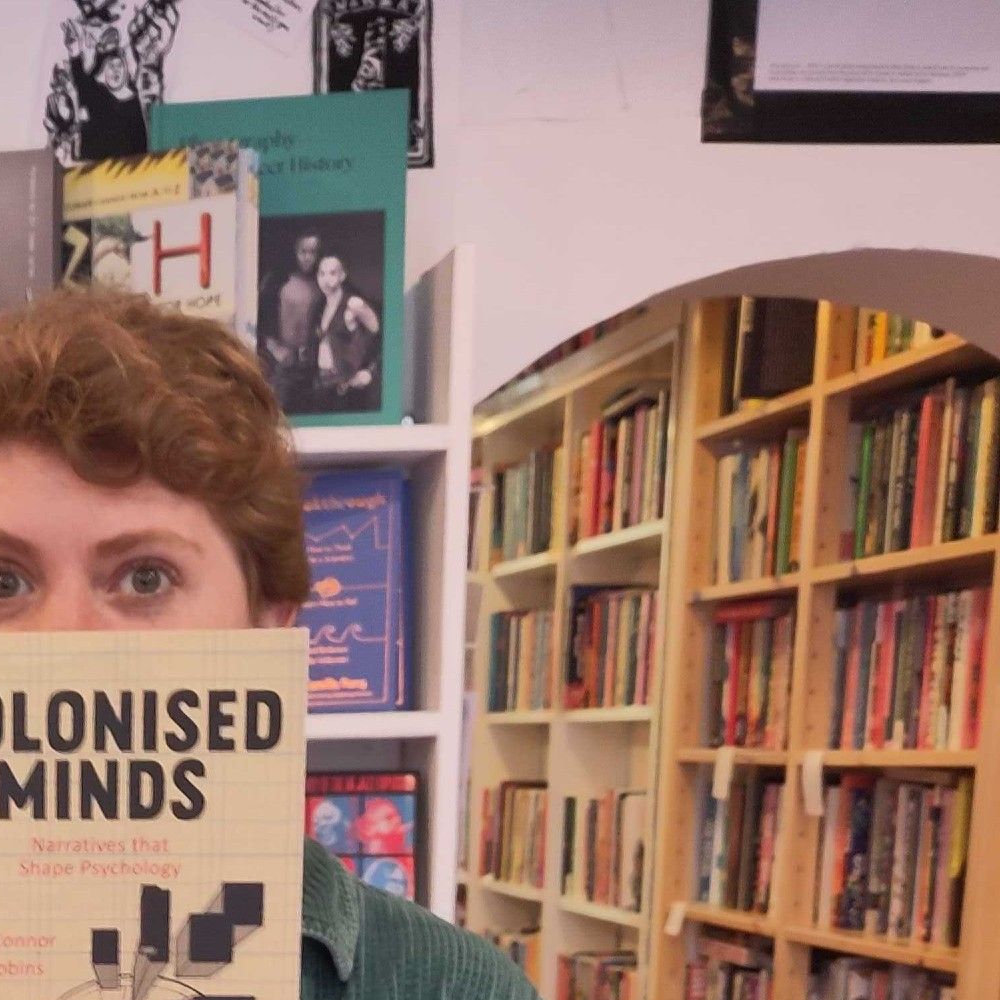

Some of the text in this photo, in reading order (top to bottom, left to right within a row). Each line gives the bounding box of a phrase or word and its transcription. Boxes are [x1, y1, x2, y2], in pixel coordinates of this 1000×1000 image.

[152, 211, 211, 296] H
[31, 836, 169, 852] Narratives that
[18, 859, 182, 879] Shape Psychology
